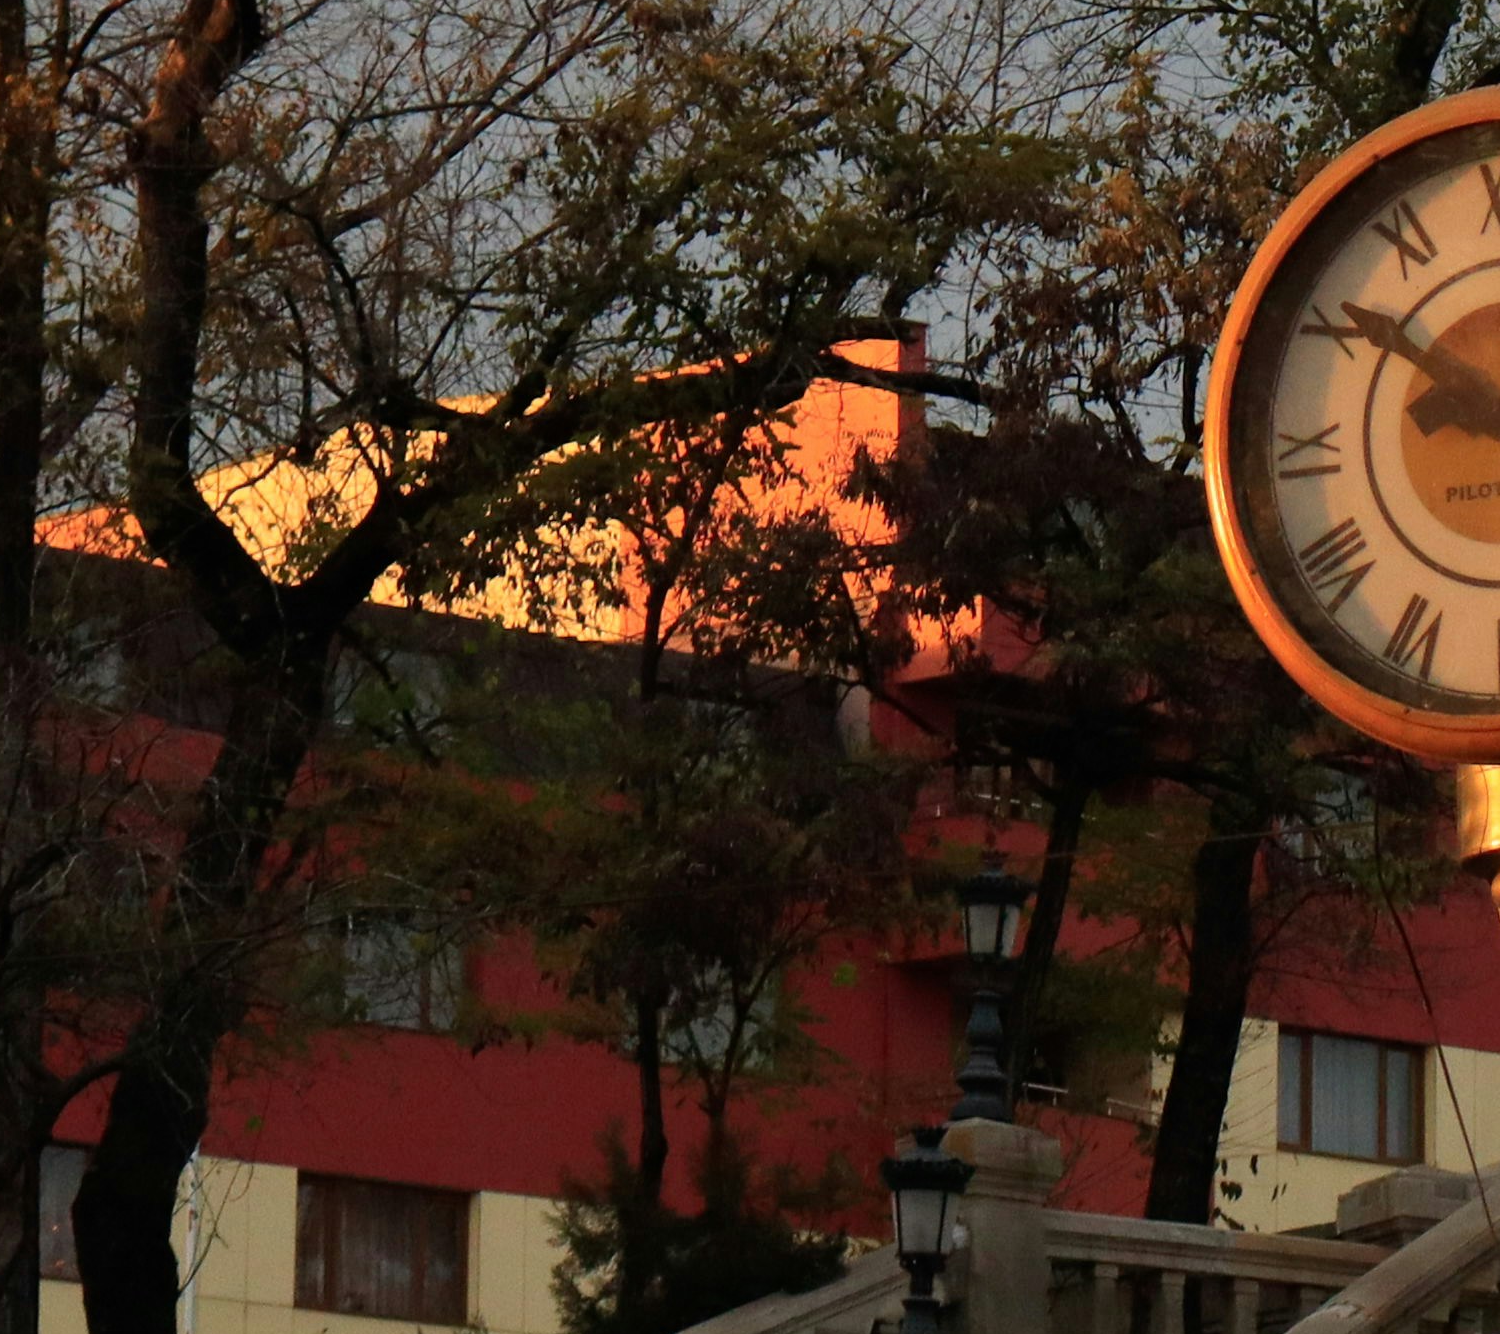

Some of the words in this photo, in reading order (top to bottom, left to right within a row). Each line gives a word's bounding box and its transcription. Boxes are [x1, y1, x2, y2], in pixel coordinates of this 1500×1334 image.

[1372, 199, 1438, 281] XI
[1299, 305, 1370, 358] X
[1279, 422, 1341, 479] IX
[1299, 517, 1376, 614] VIII
[1384, 593, 1441, 681] VII
